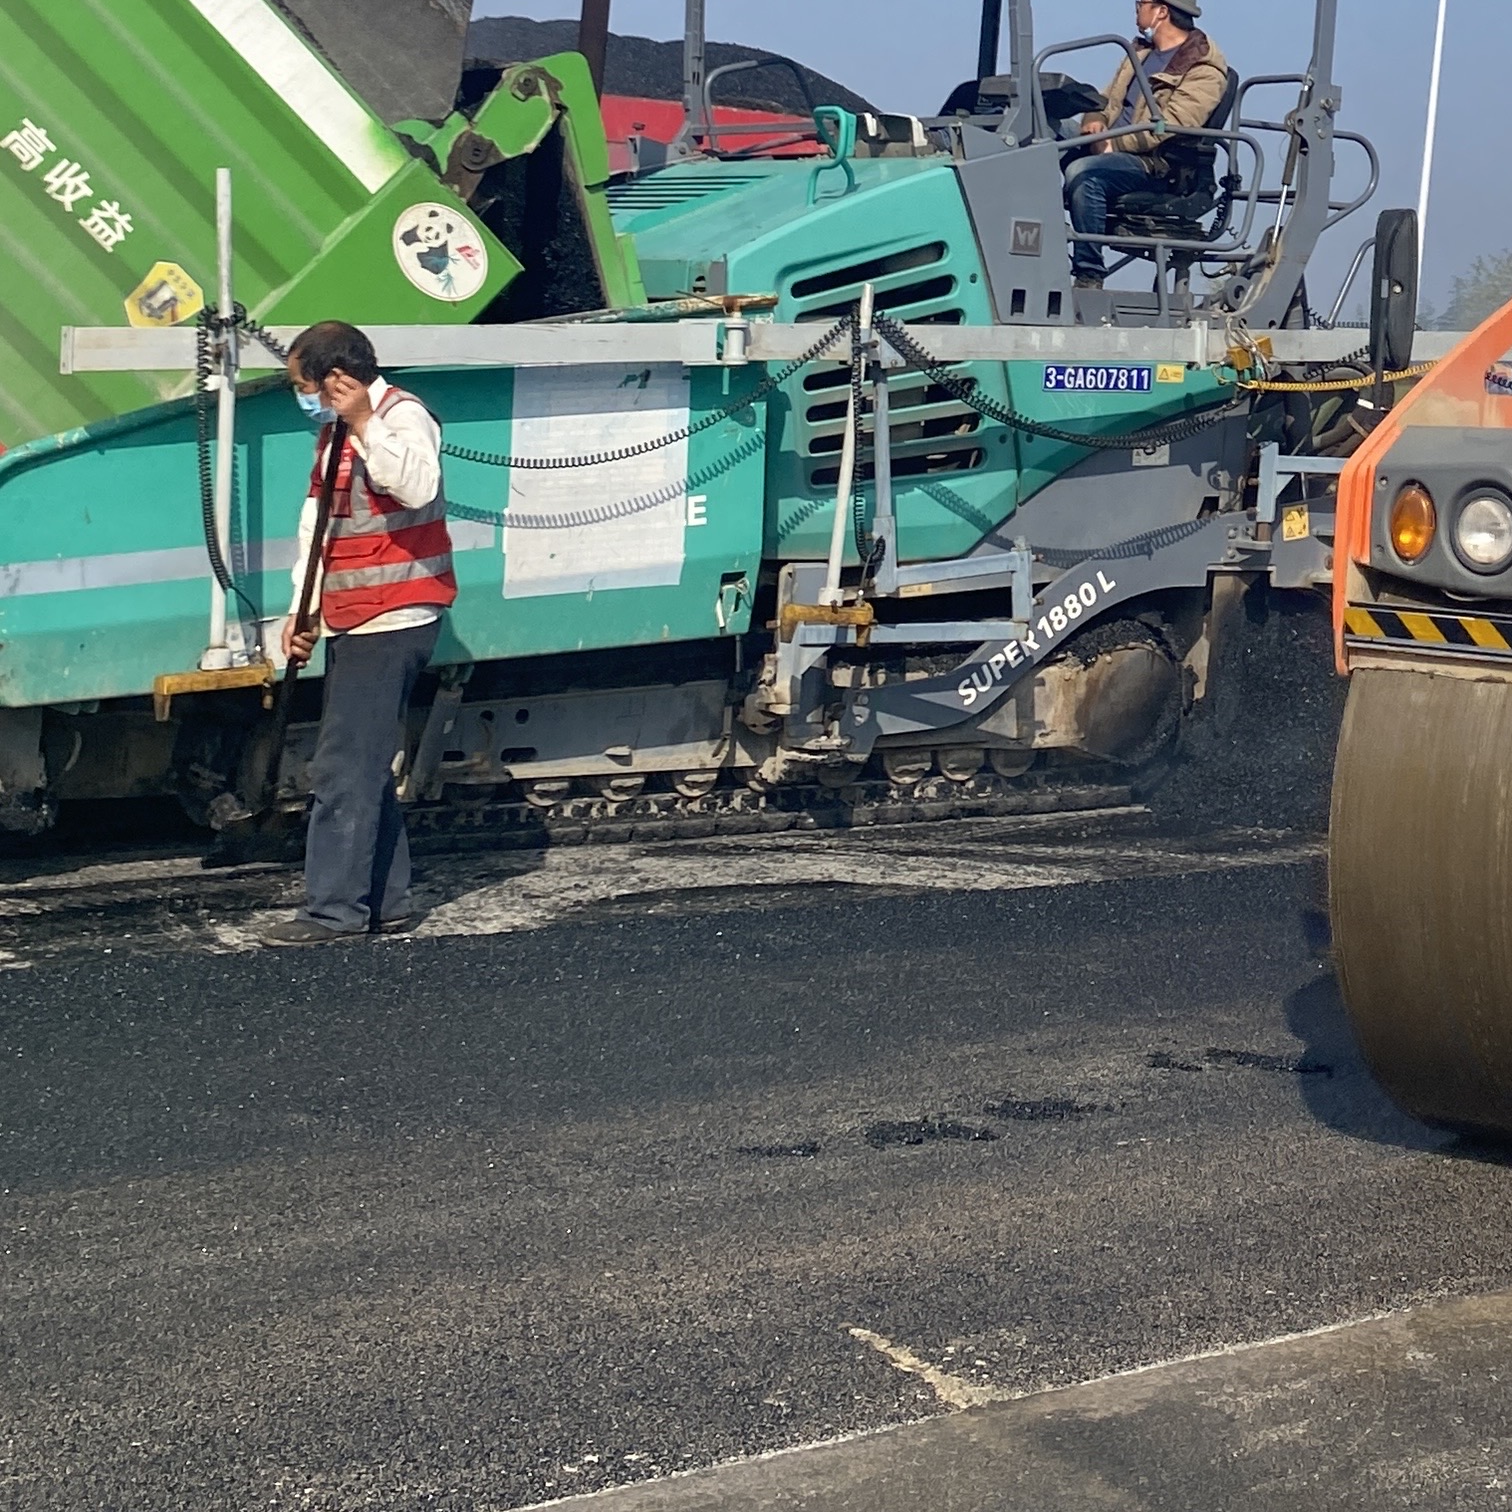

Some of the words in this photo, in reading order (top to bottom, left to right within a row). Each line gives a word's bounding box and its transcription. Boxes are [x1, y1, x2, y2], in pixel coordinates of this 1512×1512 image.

[0, 117, 134, 252] 高收益
[1046, 367, 1149, 389] 3-GA607811
[1037, 582, 1097, 638] 1880
[1096, 570, 1116, 594] L
